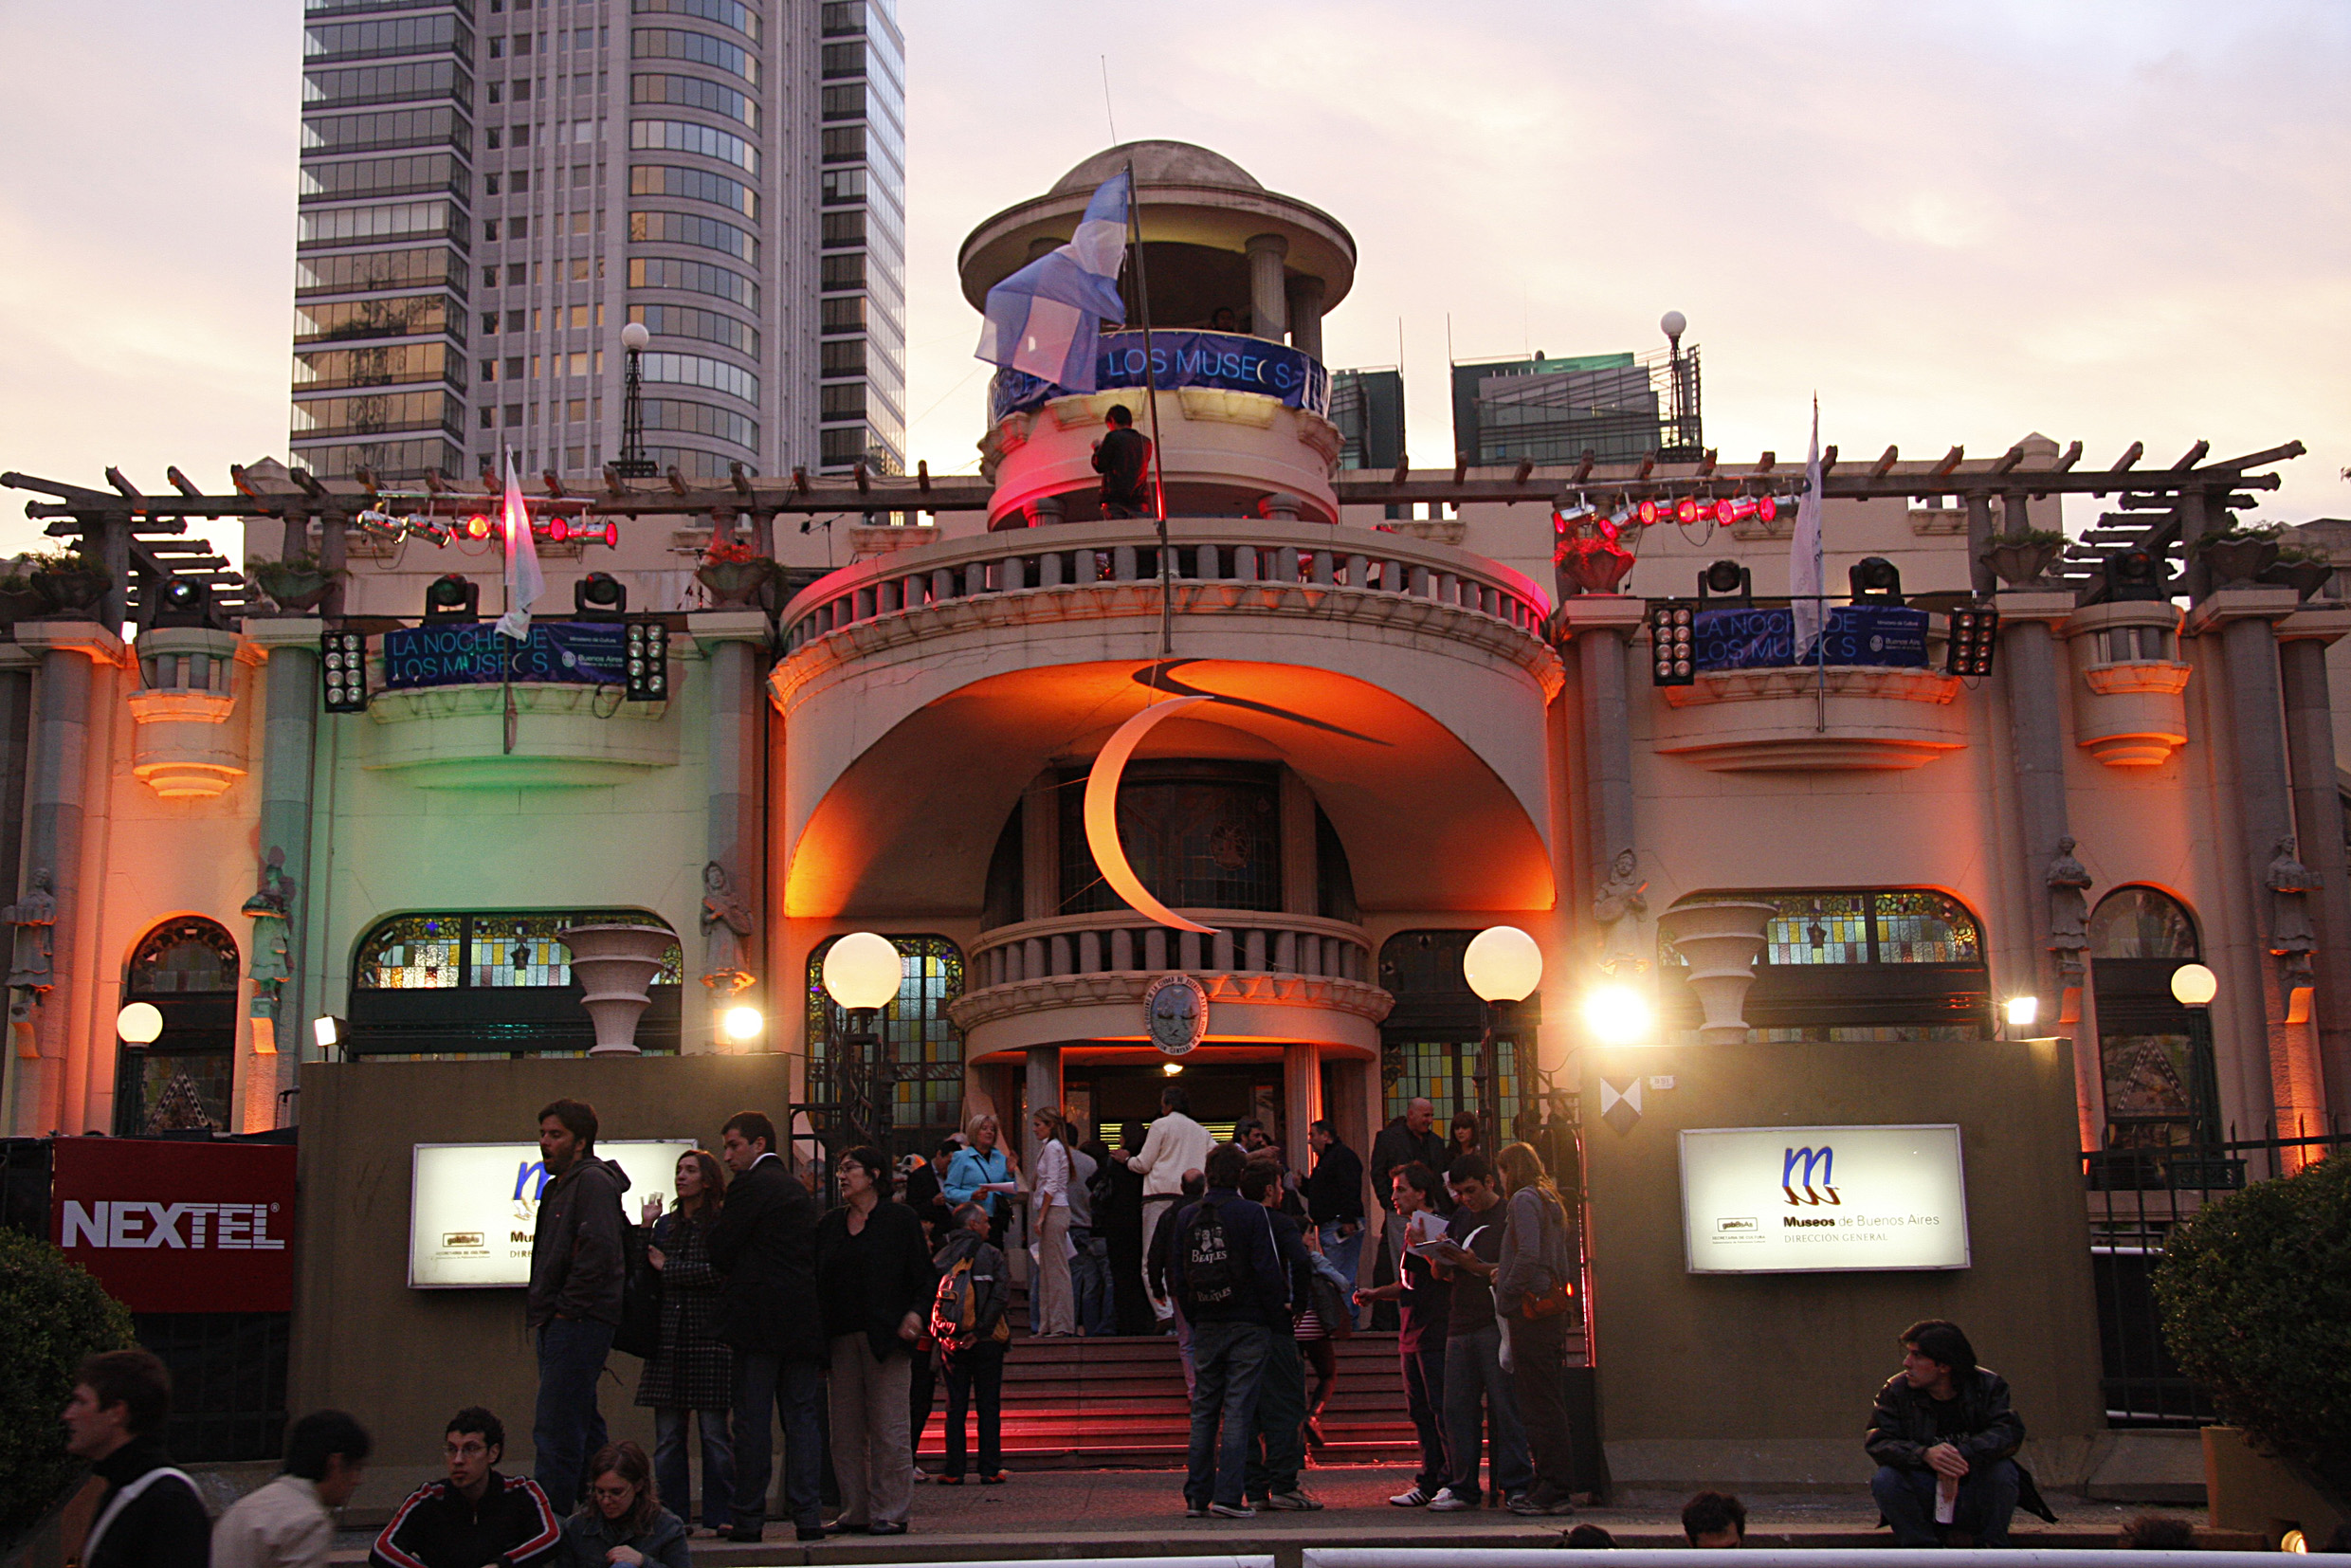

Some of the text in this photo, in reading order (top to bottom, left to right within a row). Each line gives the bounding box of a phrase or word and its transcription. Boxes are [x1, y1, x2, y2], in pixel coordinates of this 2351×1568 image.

[1108, 348, 1167, 376] LOS
[1693, 617, 1723, 638] LA
[1827, 612, 1858, 633] DE
[393, 629, 548, 656] LA NOCHE DE
[1694, 639, 1744, 663] LOS
[393, 657, 439, 679] LOS
[62, 1199, 285, 1249] NEXTEL
[1783, 1213, 1940, 1228] Museos de Buenos Aires
[1784, 1232, 1888, 1244] DIRECCIÓN GENERAL
[1192, 1249, 1227, 1264] BEATLES
[1197, 1286, 1231, 1303] BEATLES
